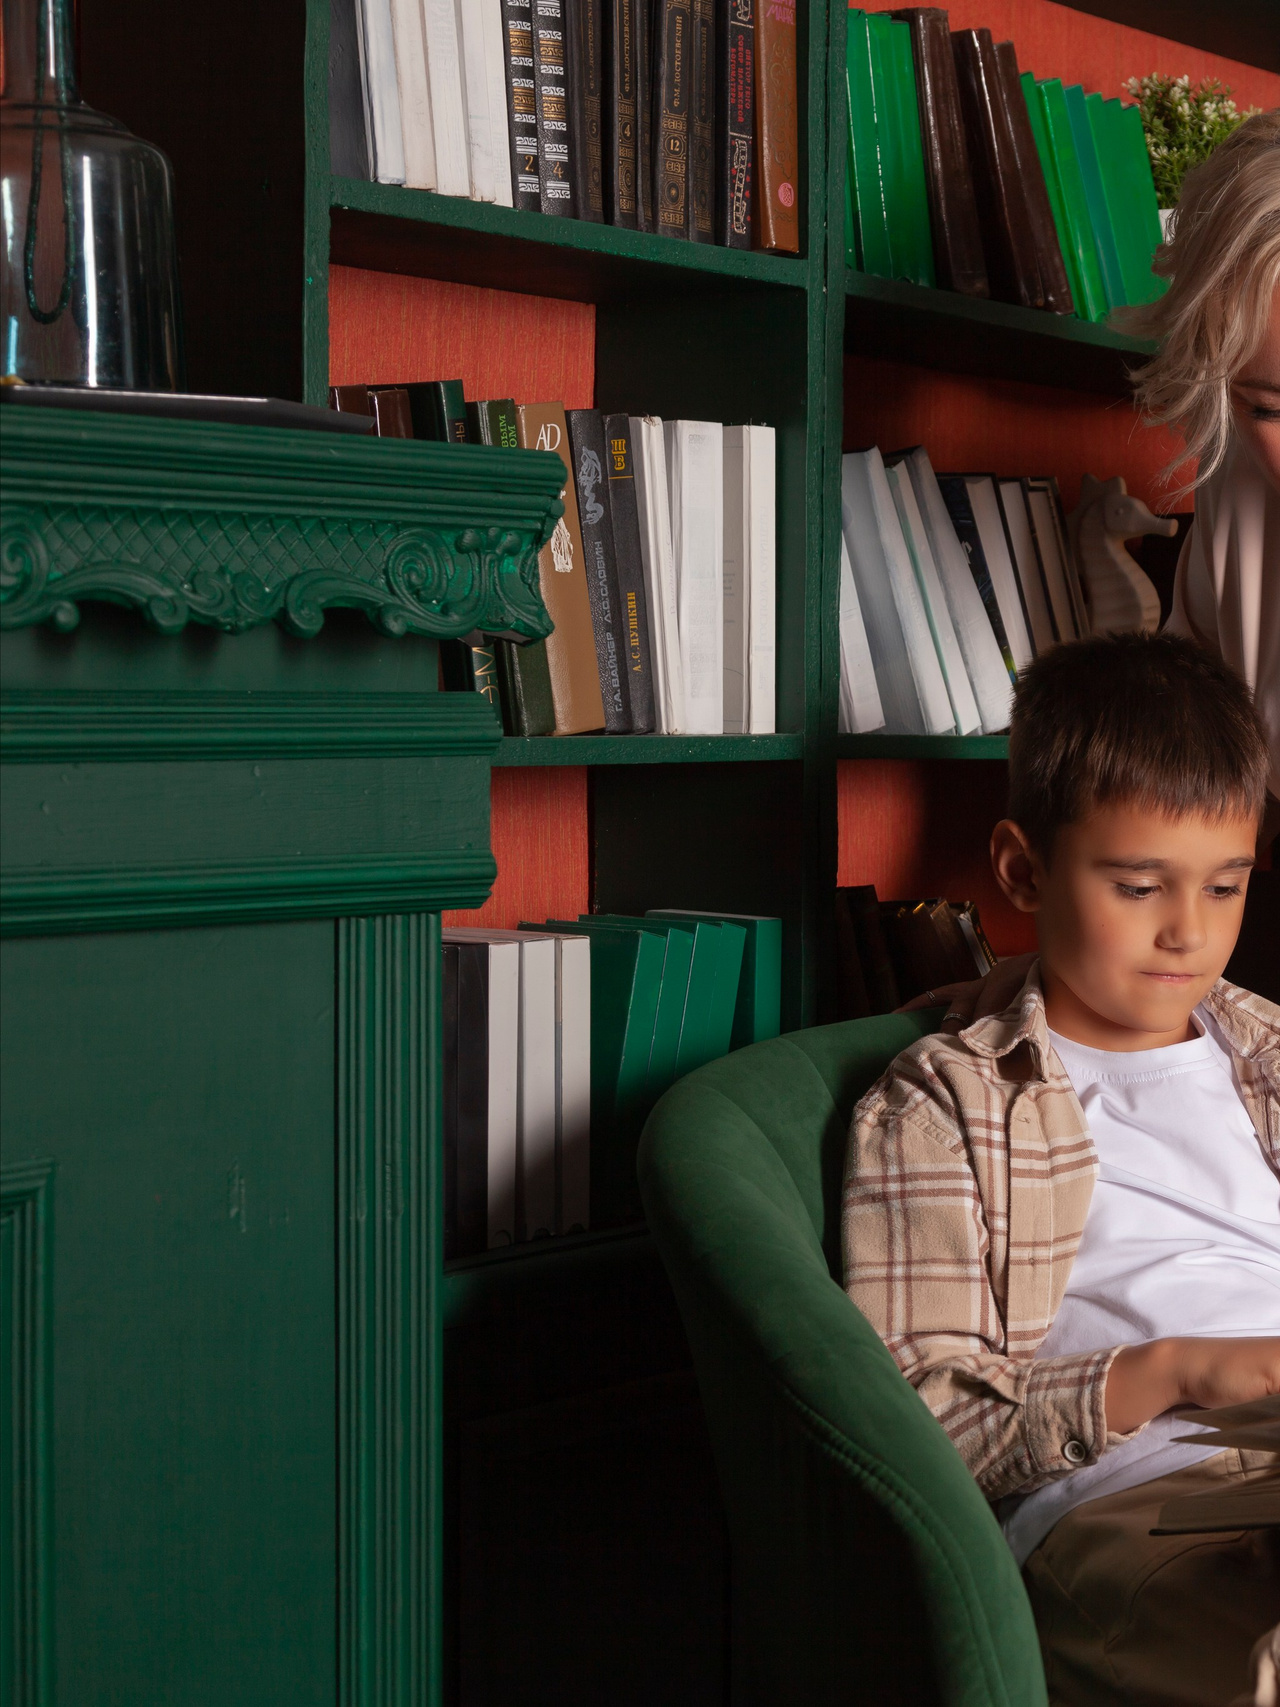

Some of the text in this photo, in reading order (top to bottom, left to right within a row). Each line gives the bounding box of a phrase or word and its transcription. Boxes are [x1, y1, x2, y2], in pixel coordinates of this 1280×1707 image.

[674, 15, 683, 86] ДОСТОЕВСКИЙ
[623, 124, 631, 137] 4
[669, 138, 680, 152] 12
[524, 154, 534, 173] 2
[553, 161, 564, 179] 4
